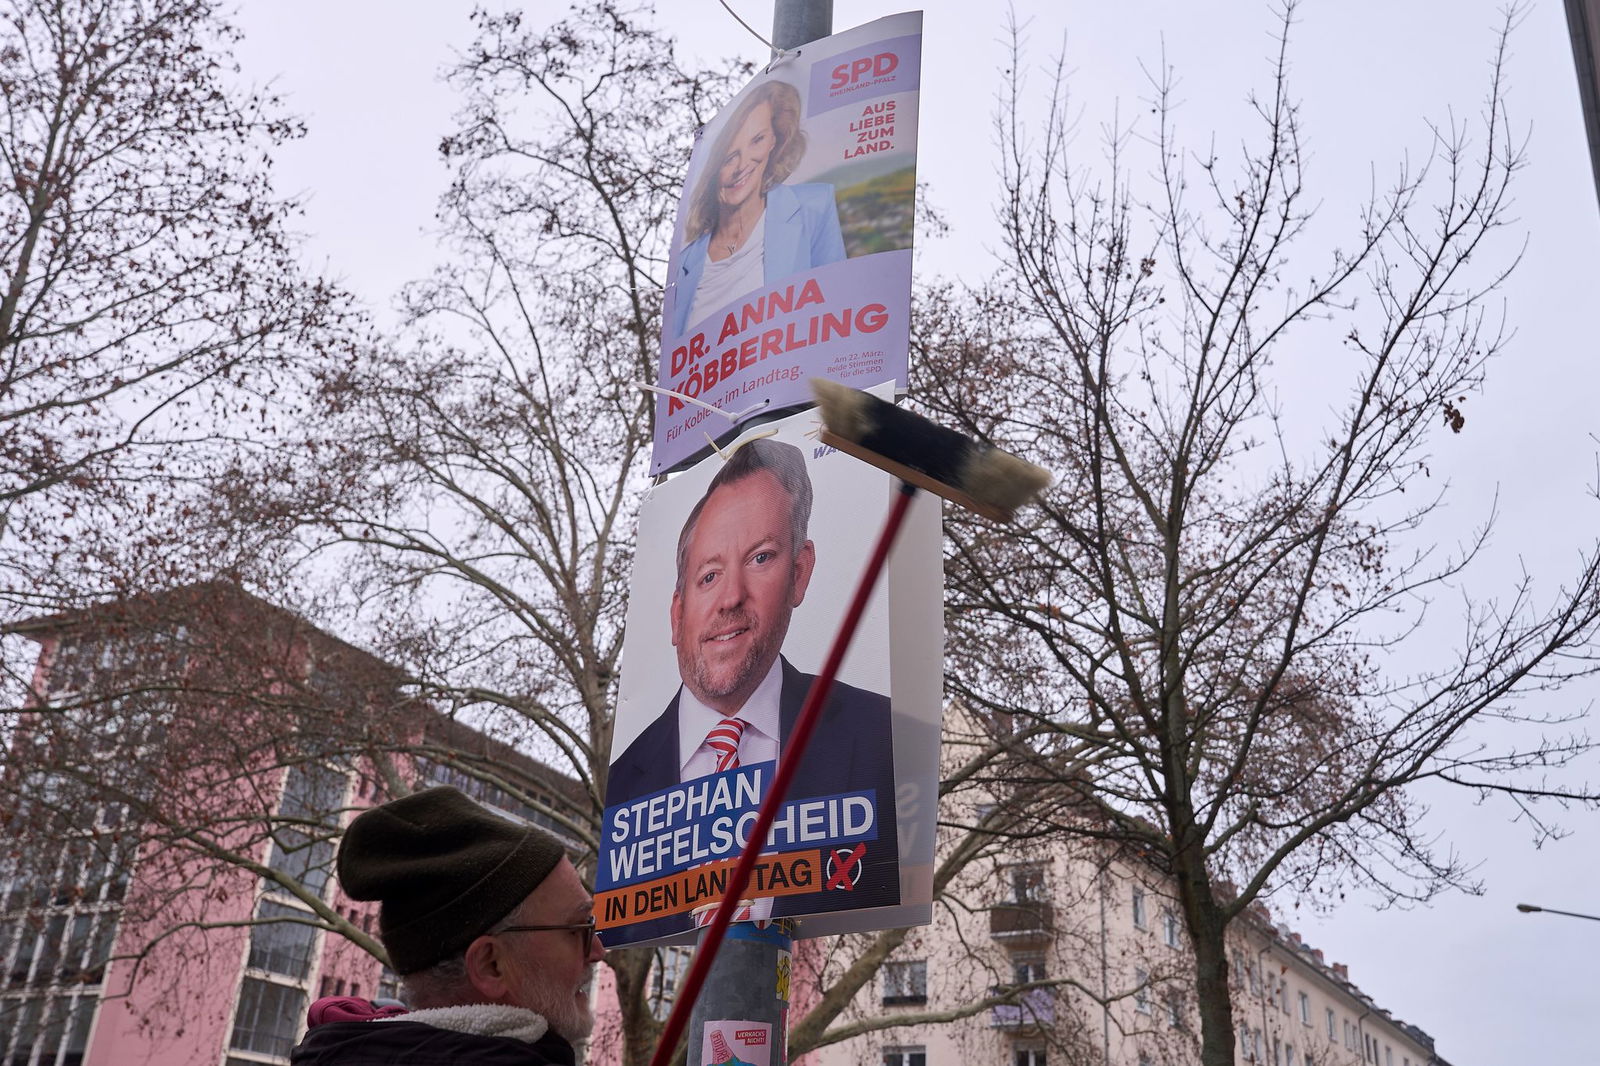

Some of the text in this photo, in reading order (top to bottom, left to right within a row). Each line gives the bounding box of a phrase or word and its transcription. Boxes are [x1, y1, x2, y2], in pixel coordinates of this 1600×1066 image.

[830, 52, 899, 90] SPD
[849, 113, 895, 133] LIEBE
[862, 100, 896, 117] AUS
[857, 126, 895, 143] ZUM
[844, 140, 895, 159] LAND.
[671, 278, 825, 378] DR. ANNA
[668, 303, 889, 417] KÖBBERLING
[827, 358, 884, 374] Beide Stimmen
[849, 353, 860, 361] 22.
[840, 371, 850, 379] für
[852, 368, 864, 376] die
[666, 424, 683, 444] Für
[725, 387, 739, 404] im
[742, 365, 804, 395] Landtag.
[611, 769, 761, 843] STEPHAN
[609, 795, 875, 883] WEFELSCHEID
[604, 858, 812, 922] IN DEN LANTAG
